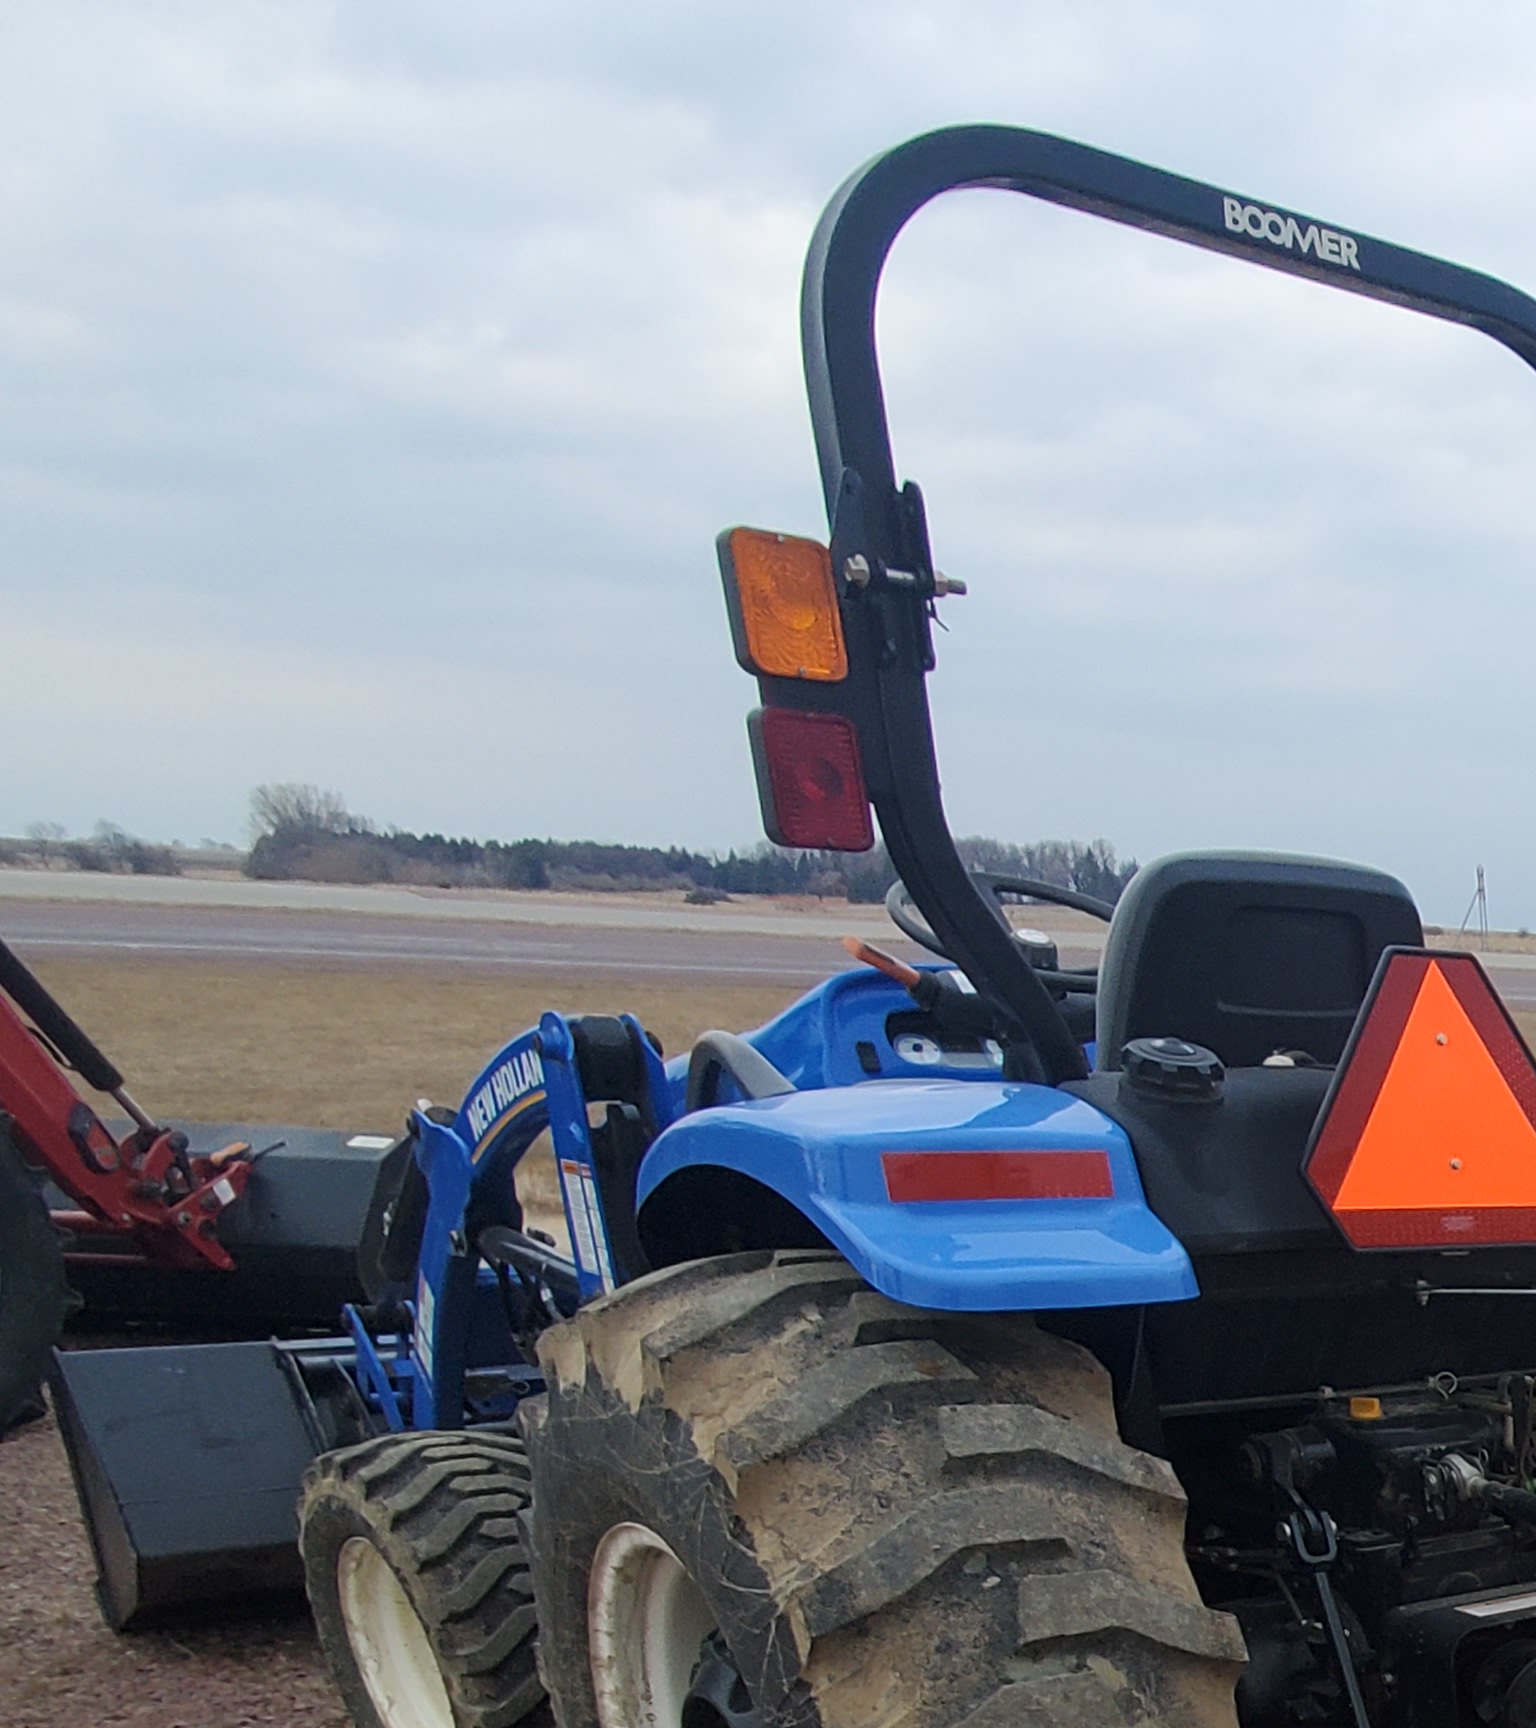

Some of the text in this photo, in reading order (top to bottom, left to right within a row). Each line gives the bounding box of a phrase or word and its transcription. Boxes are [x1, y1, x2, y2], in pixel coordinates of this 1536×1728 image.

[1223, 196, 1361, 271] BOOMER
[467, 1049, 545, 1142] NEW HOLLAN
